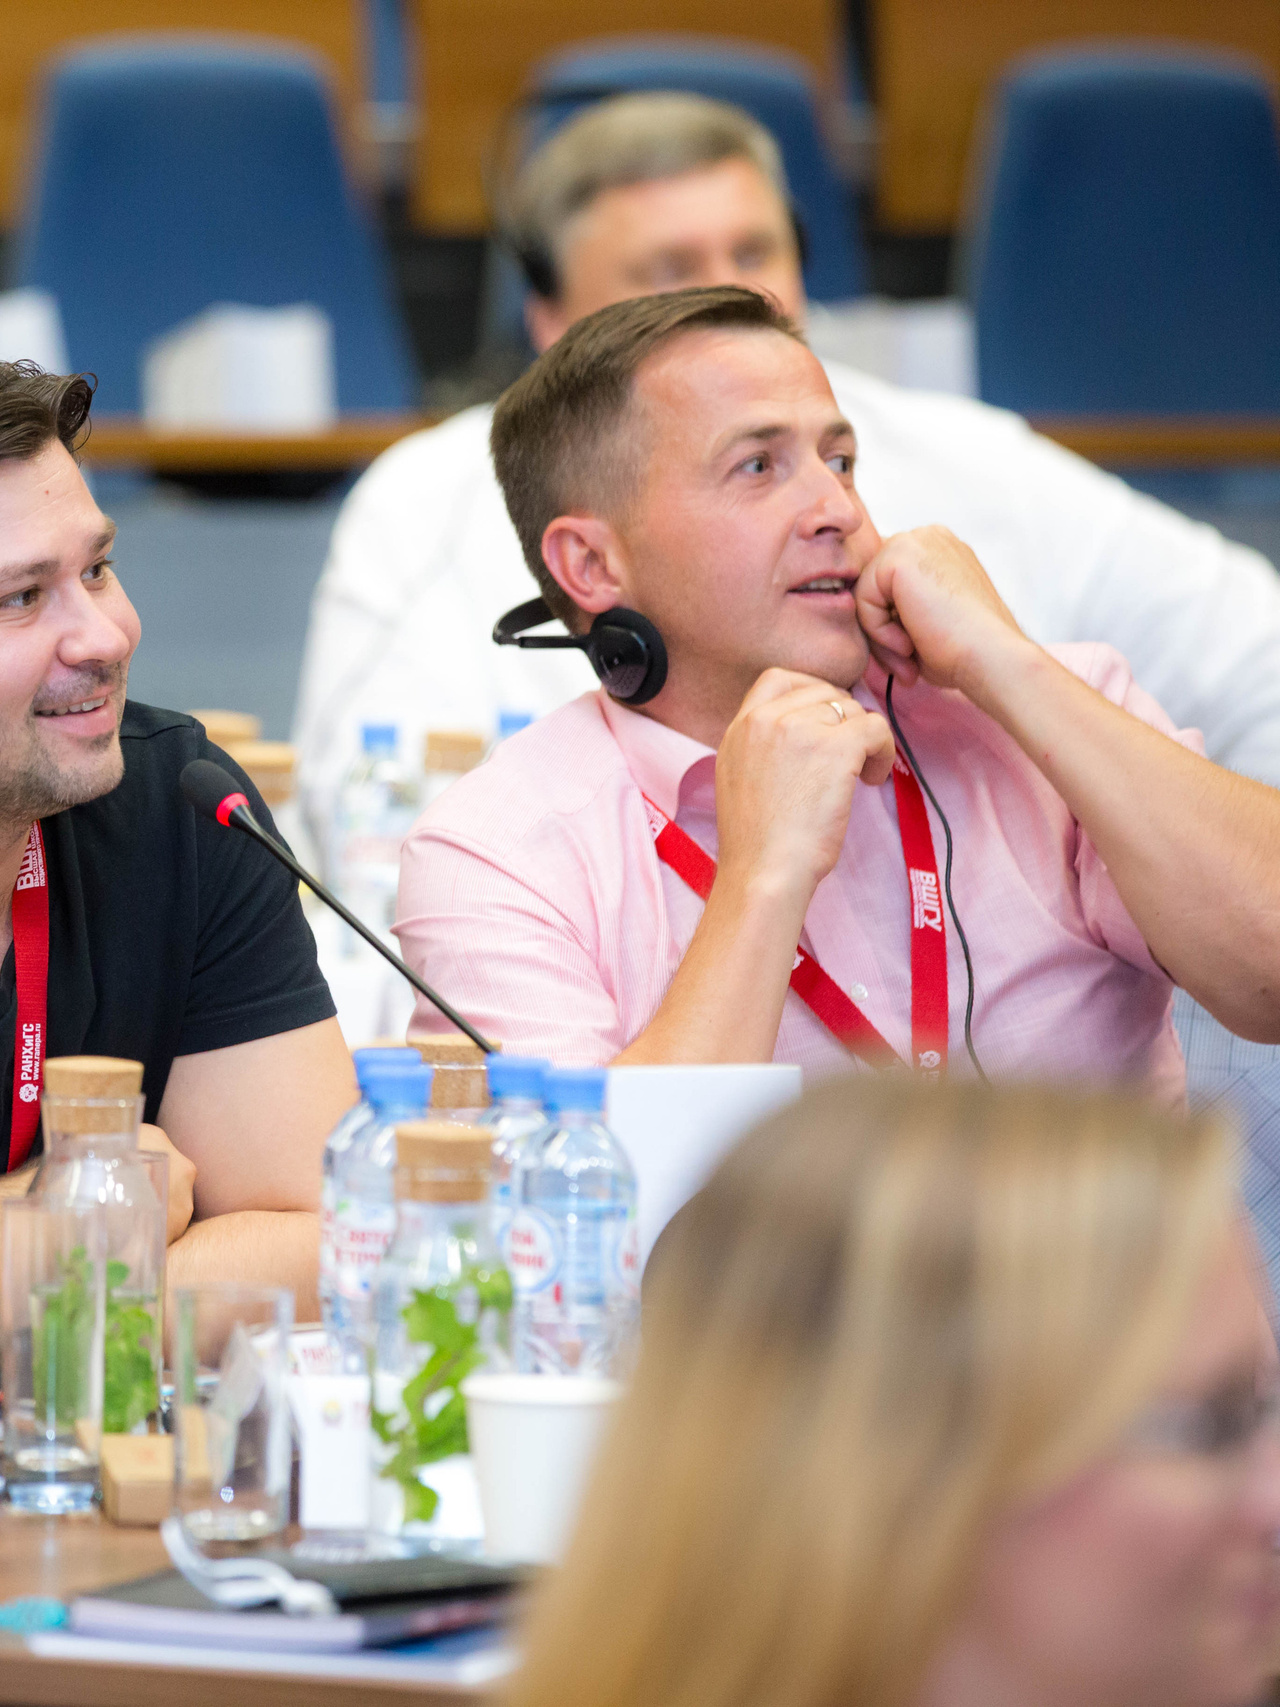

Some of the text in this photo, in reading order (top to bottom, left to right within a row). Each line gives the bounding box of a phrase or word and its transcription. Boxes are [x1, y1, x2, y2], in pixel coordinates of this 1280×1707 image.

[31, 850, 40, 887] ВЫСШАЯ
[919, 871, 942, 933] ВШГУ
[20, 1023, 34, 1081] РАНХиГС
[33, 1023, 42, 1081] www.ranepa.ru
